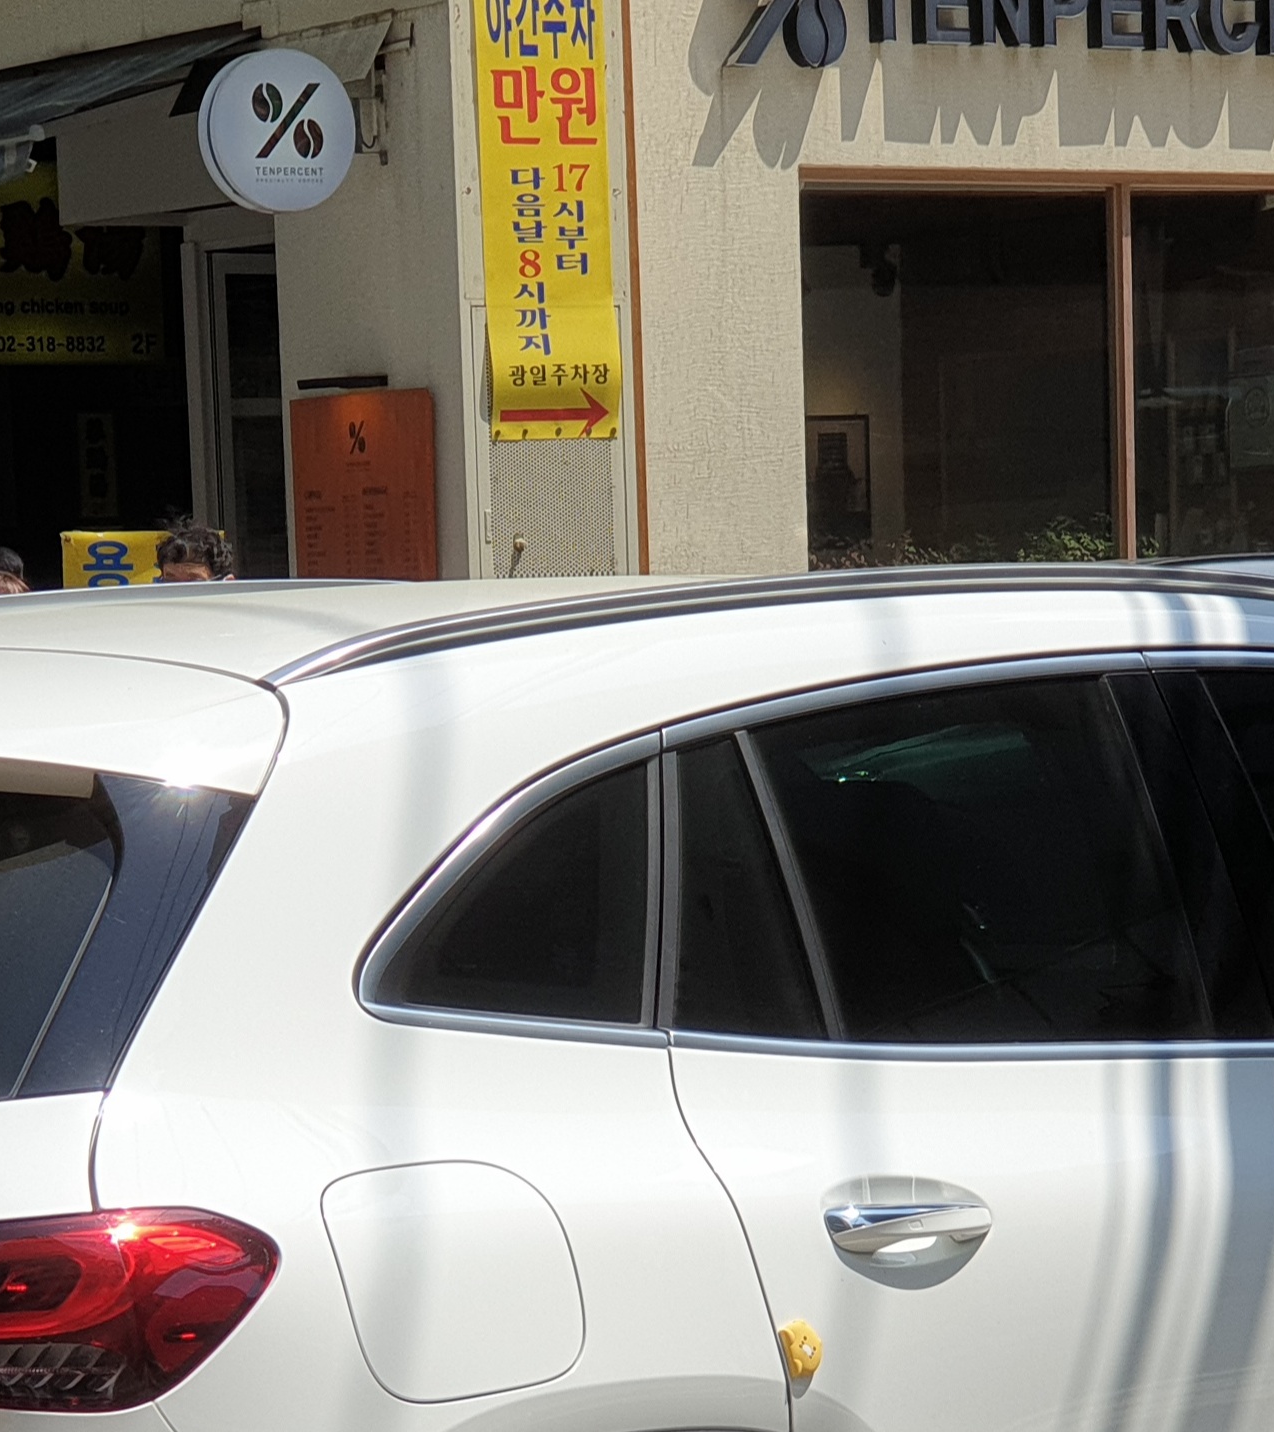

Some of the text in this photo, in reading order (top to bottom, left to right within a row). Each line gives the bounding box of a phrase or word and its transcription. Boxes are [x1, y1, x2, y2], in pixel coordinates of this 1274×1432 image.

[486, 0, 596, 59] 야간주차
[490, 65, 598, 146] 만원
[255, 166, 324, 177] TENPERCENT
[21, 298, 84, 315] chicken
[89, 302, 130, 317] soup
[132, 334, 158, 355] 2F
[508, 363, 611, 387] 광일주차장
